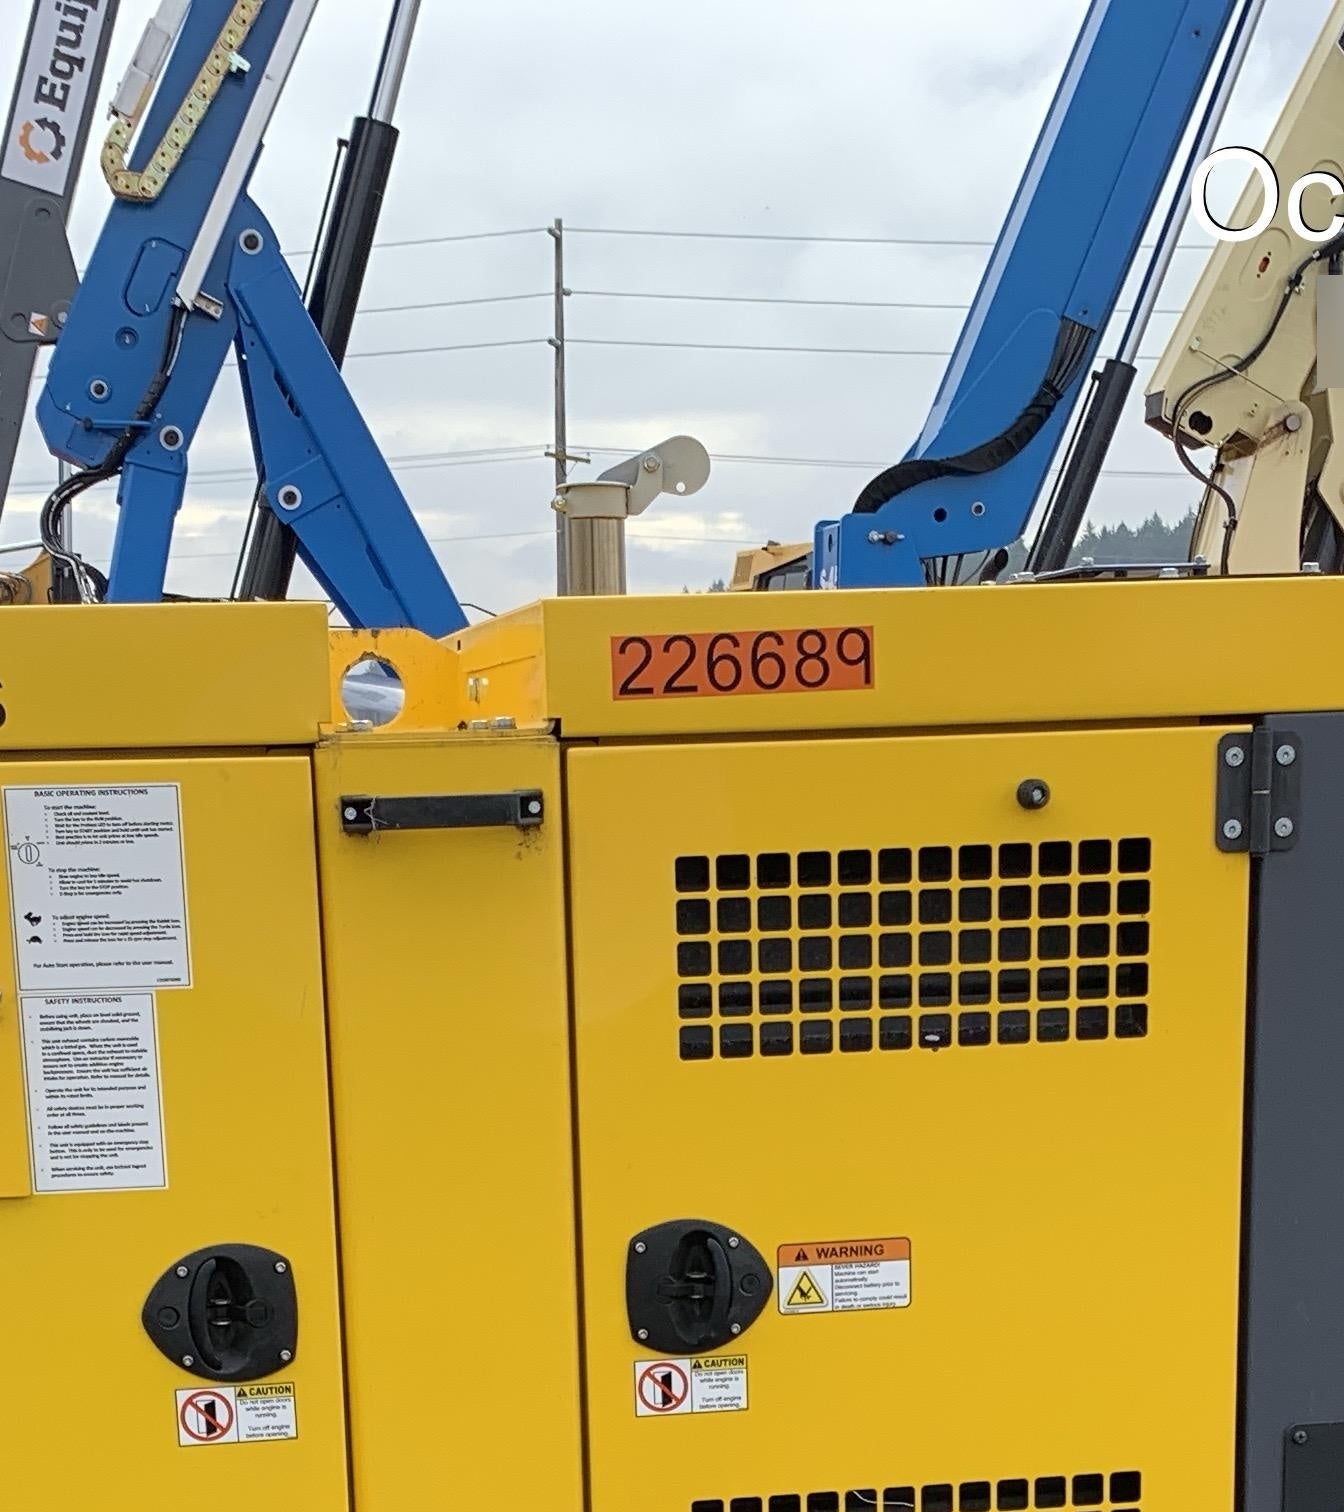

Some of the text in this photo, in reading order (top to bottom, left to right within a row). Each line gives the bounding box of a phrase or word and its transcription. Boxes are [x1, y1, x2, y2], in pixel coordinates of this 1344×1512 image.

[33, 0, 99, 113] Equi
[616, 627, 873, 697] 226689
[816, 1244, 884, 1259] WARNING
[704, 1358, 744, 1368] CAUTION
[249, 1386, 291, 1396] CAUTION
